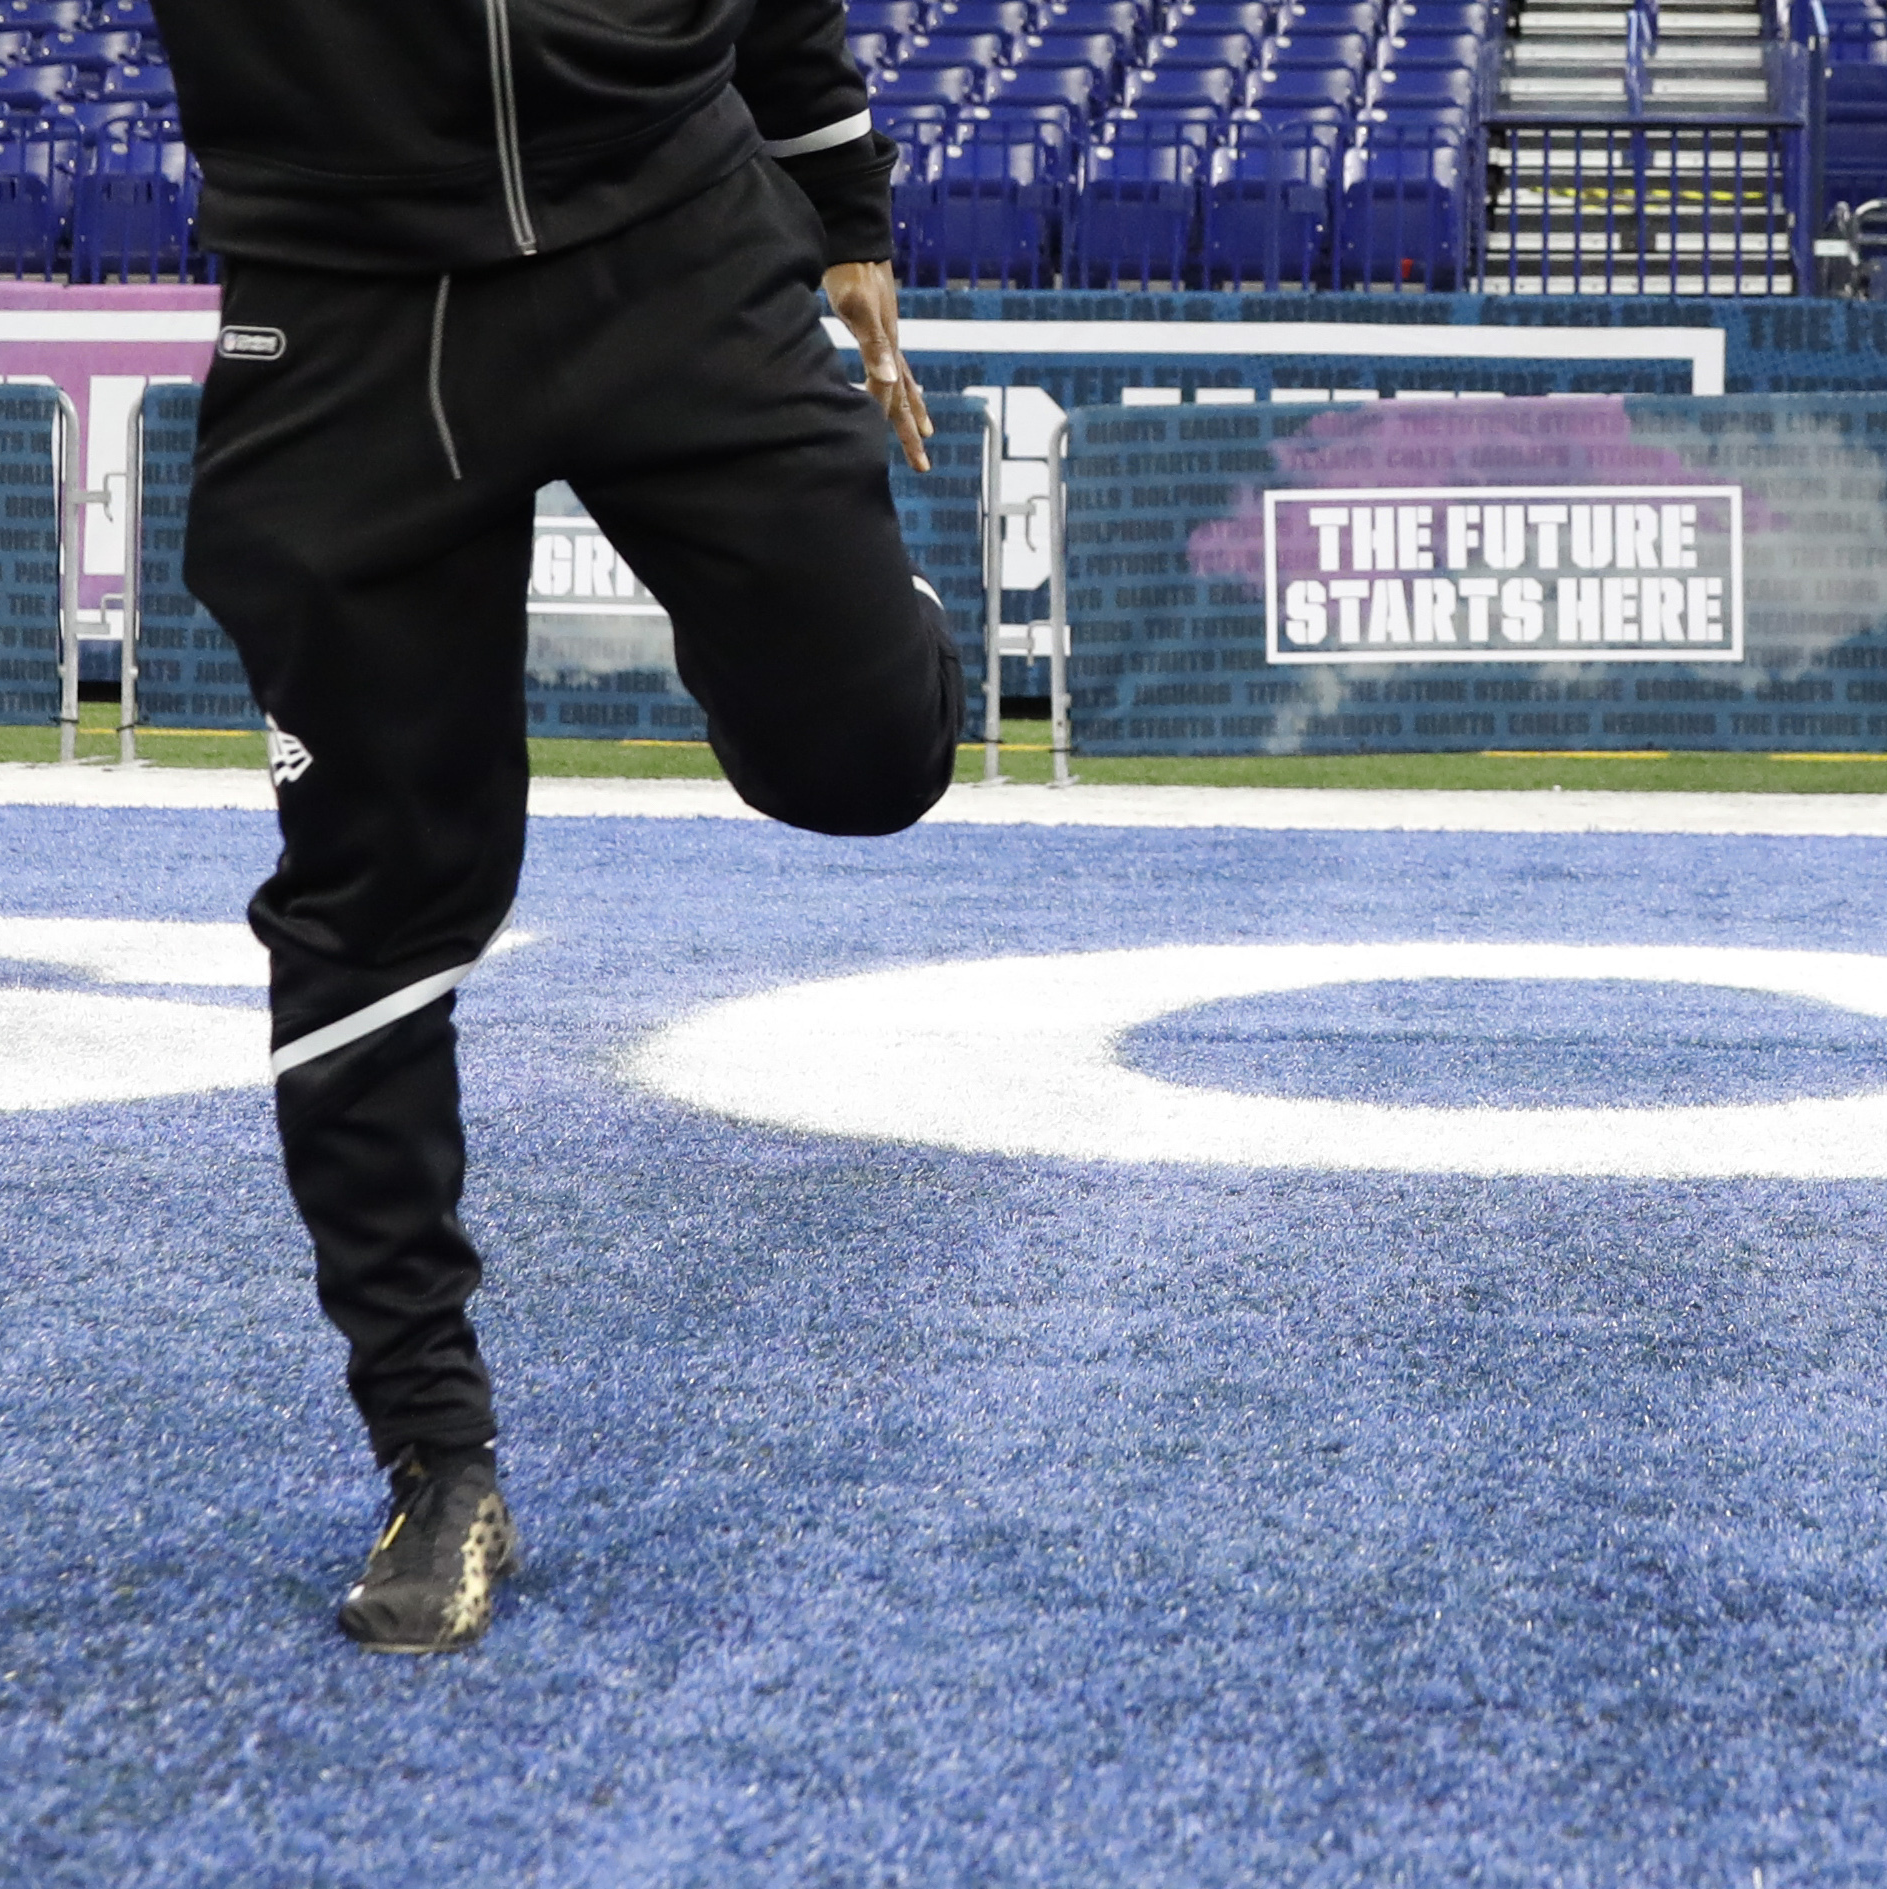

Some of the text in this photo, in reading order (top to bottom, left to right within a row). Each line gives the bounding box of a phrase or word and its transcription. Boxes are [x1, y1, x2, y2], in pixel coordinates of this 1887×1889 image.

[1307, 503, 1698, 573] THE FUTURE
[1284, 576, 1725, 645] STARTS HERE
